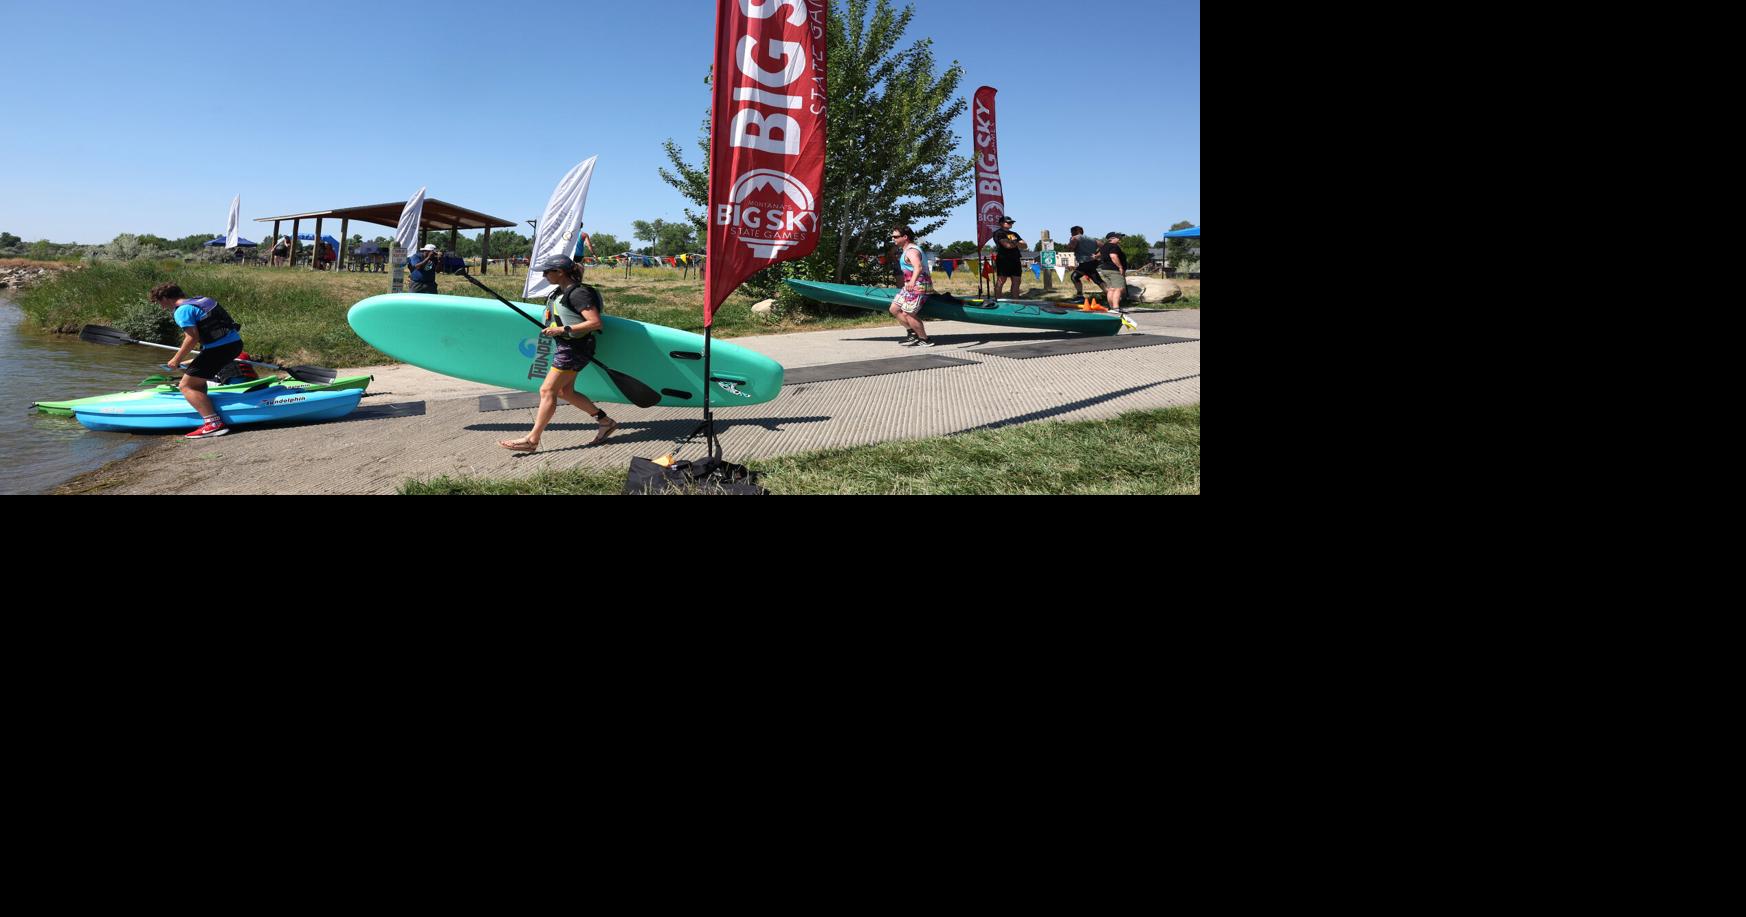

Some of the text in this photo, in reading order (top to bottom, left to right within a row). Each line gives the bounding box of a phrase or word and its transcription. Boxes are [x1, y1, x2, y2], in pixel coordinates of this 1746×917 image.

[730, 34, 807, 156] BIG
[809, 45, 828, 116] STATE
[976, 97, 1002, 196] BIG SKY
[717, 203, 819, 232] BIG SKY
[747, 200, 793, 211] MONTANA'S
[730, 227, 807, 240] STATE GAMES
